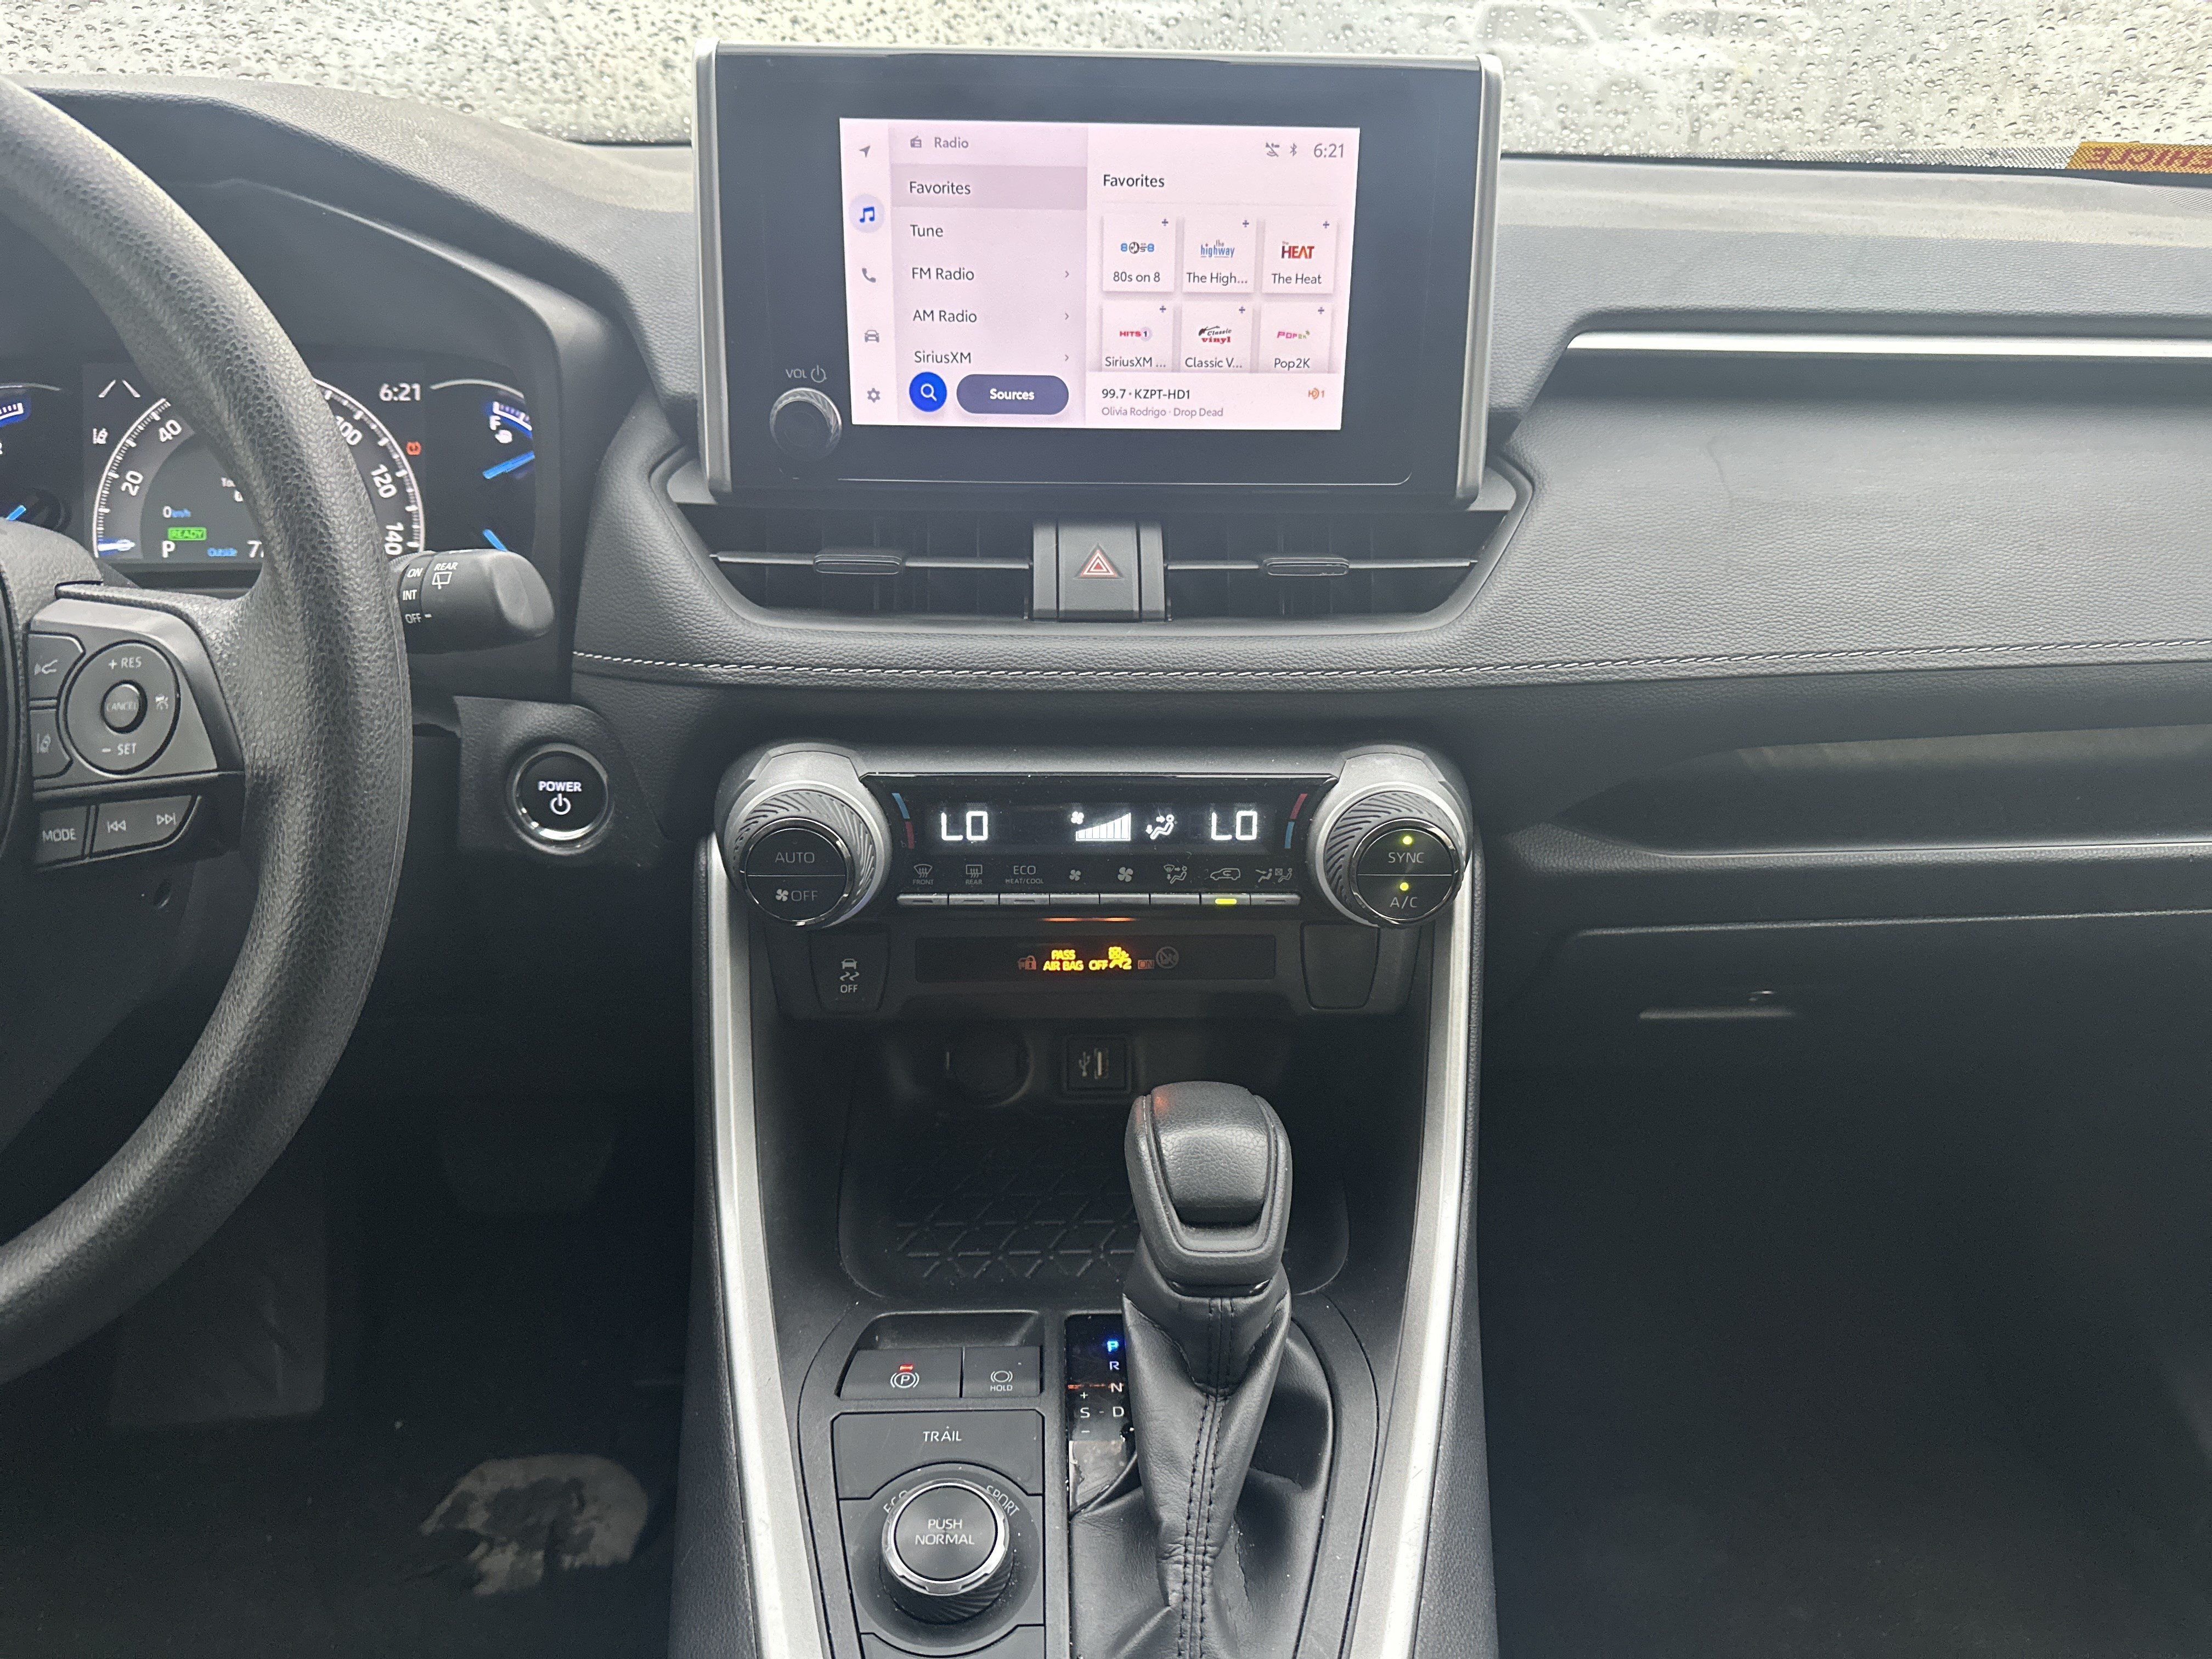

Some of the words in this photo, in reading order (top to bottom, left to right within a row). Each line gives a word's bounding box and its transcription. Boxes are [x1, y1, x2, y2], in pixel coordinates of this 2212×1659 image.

[934, 137, 969, 149] Radio
[1313, 144, 1345, 158] 6:21
[1103, 174, 1165, 188] Favorites
[909, 181, 971, 195] Favorites
[910, 224, 944, 237] Tune
[1200, 245, 1235, 258] highway
[1281, 245, 1315, 259] HEAT
[911, 267, 932, 280] FM
[935, 267, 975, 281] Radio
[1113, 272, 1133, 283] 80s
[1136, 273, 1151, 283] on
[1153, 272, 1161, 283] 8
[1187, 272, 1207, 283] The
[1272, 273, 1292, 284] The
[1295, 273, 1322, 285] Heat
[913, 310, 934, 321] AM
[939, 310, 978, 323] Radio
[1207, 328, 1232, 336] Classic
[1201, 336, 1232, 345] vinyl
[914, 351, 972, 364] SiriusXM
[1105, 357, 1153, 368] SiriusXM
[1185, 357, 1223, 368] Classic
[1274, 358, 1311, 371] Pop2K
[785, 368, 808, 379] VOL
[379, 383, 421, 401] 6:21
[990, 388, 1035, 400] Sources
[1102, 389, 1126, 399] 99.7
[1134, 389, 1190, 400] KZPT-HD1
[1102, 407, 1128, 416] Olivia
[1130, 407, 1166, 418] Rodrigo
[1173, 408, 1197, 419] Drop
[1199, 408, 1223, 417] Dead
[489, 415, 501, 431] F
[158, 419, 182, 443] 40
[335, 416, 362, 445] 100
[121, 470, 144, 496] 20
[370, 464, 397, 499] 120
[384, 522, 404, 556] 140
[162, 540, 176, 558] P
[433, 562, 459, 571] REAR
[407, 568, 423, 578] ON
[402, 590, 417, 601] INT
[405, 613, 422, 623] OFF
[121, 657, 142, 668] RES
[116, 743, 137, 755] SET
[538, 780, 582, 792] POWER
[941, 811, 988, 841] LO
[1211, 810, 1258, 841] LO
[42, 828, 77, 842] MODE
[774, 851, 815, 864] AUTO
[1387, 851, 1425, 864] SYNC
[1013, 865, 1036, 876] ECO
[791, 890, 819, 902] OFF
[1390, 896, 1418, 909] A/C
[1051, 949, 1076, 960] PASS
[1042, 960, 1060, 971] AIR
[1062, 960, 1084, 971] BAG
[1088, 960, 1109, 970] OFF
[840, 984, 859, 994] OFF
[1107, 1340, 1119, 1352] P
[1109, 1361, 1119, 1370] R
[1110, 1383, 1122, 1392] N
[1080, 1407, 1091, 1418] S
[1113, 1407, 1125, 1417] D
[923, 1431, 962, 1442] TRAIL
[928, 1518, 963, 1530] PUSH
[915, 1534, 975, 1545] NORMAL
